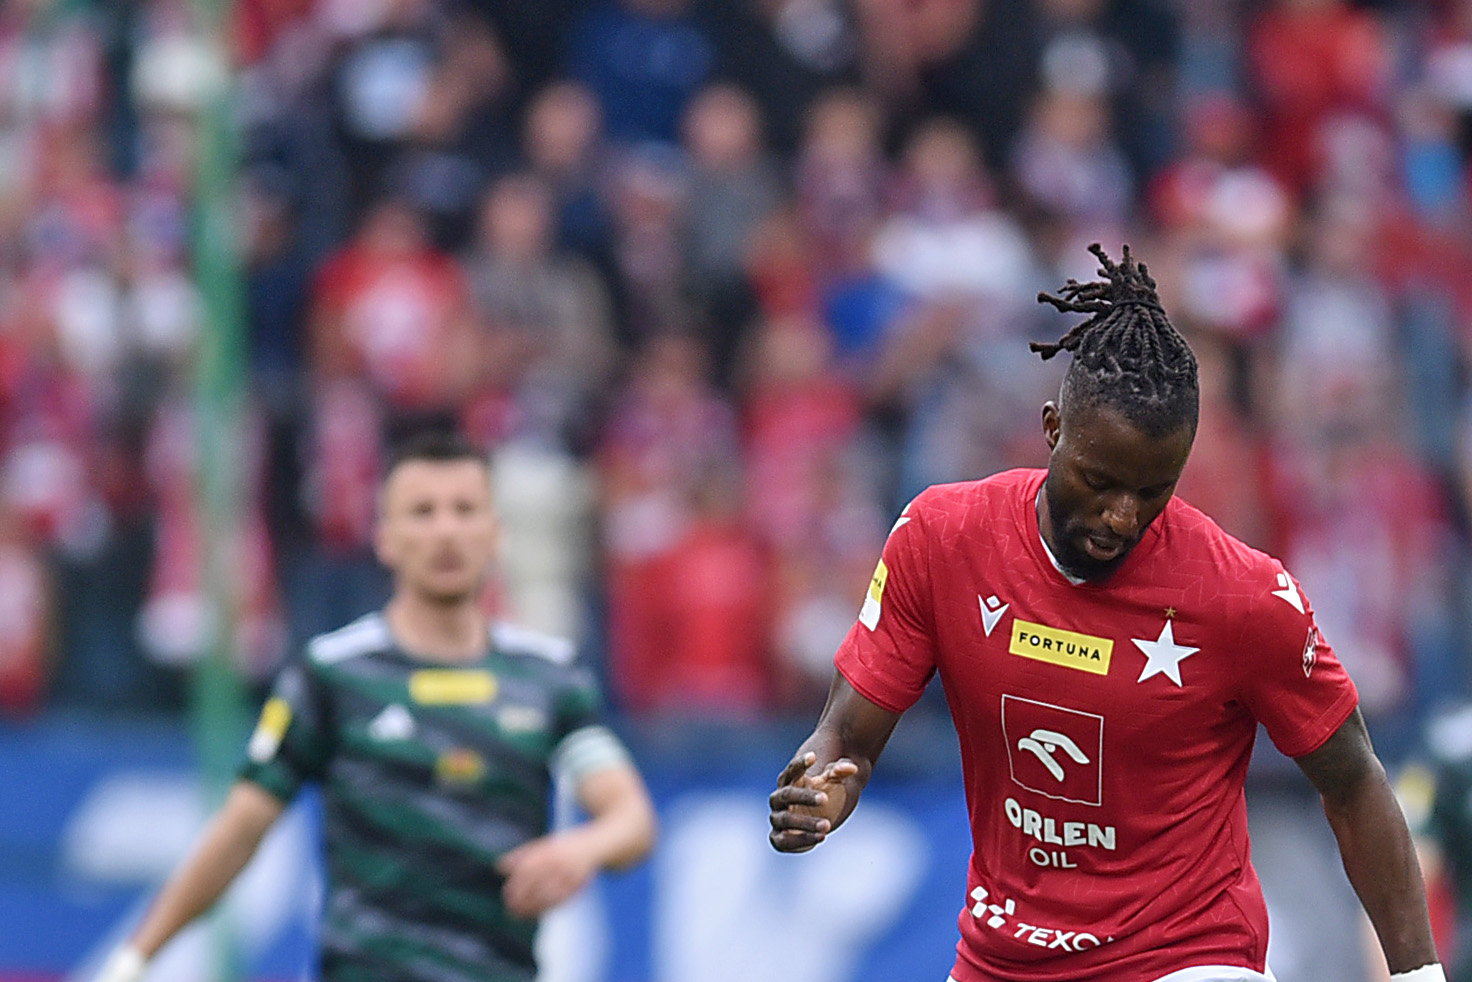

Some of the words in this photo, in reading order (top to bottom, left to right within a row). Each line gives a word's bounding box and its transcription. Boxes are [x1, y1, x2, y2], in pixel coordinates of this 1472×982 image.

[1018, 631, 1101, 661] FORTUNA
[1004, 797, 1116, 851] ORLEN
[1029, 847, 1078, 868] OIL
[1013, 922, 1115, 952] TEXO
